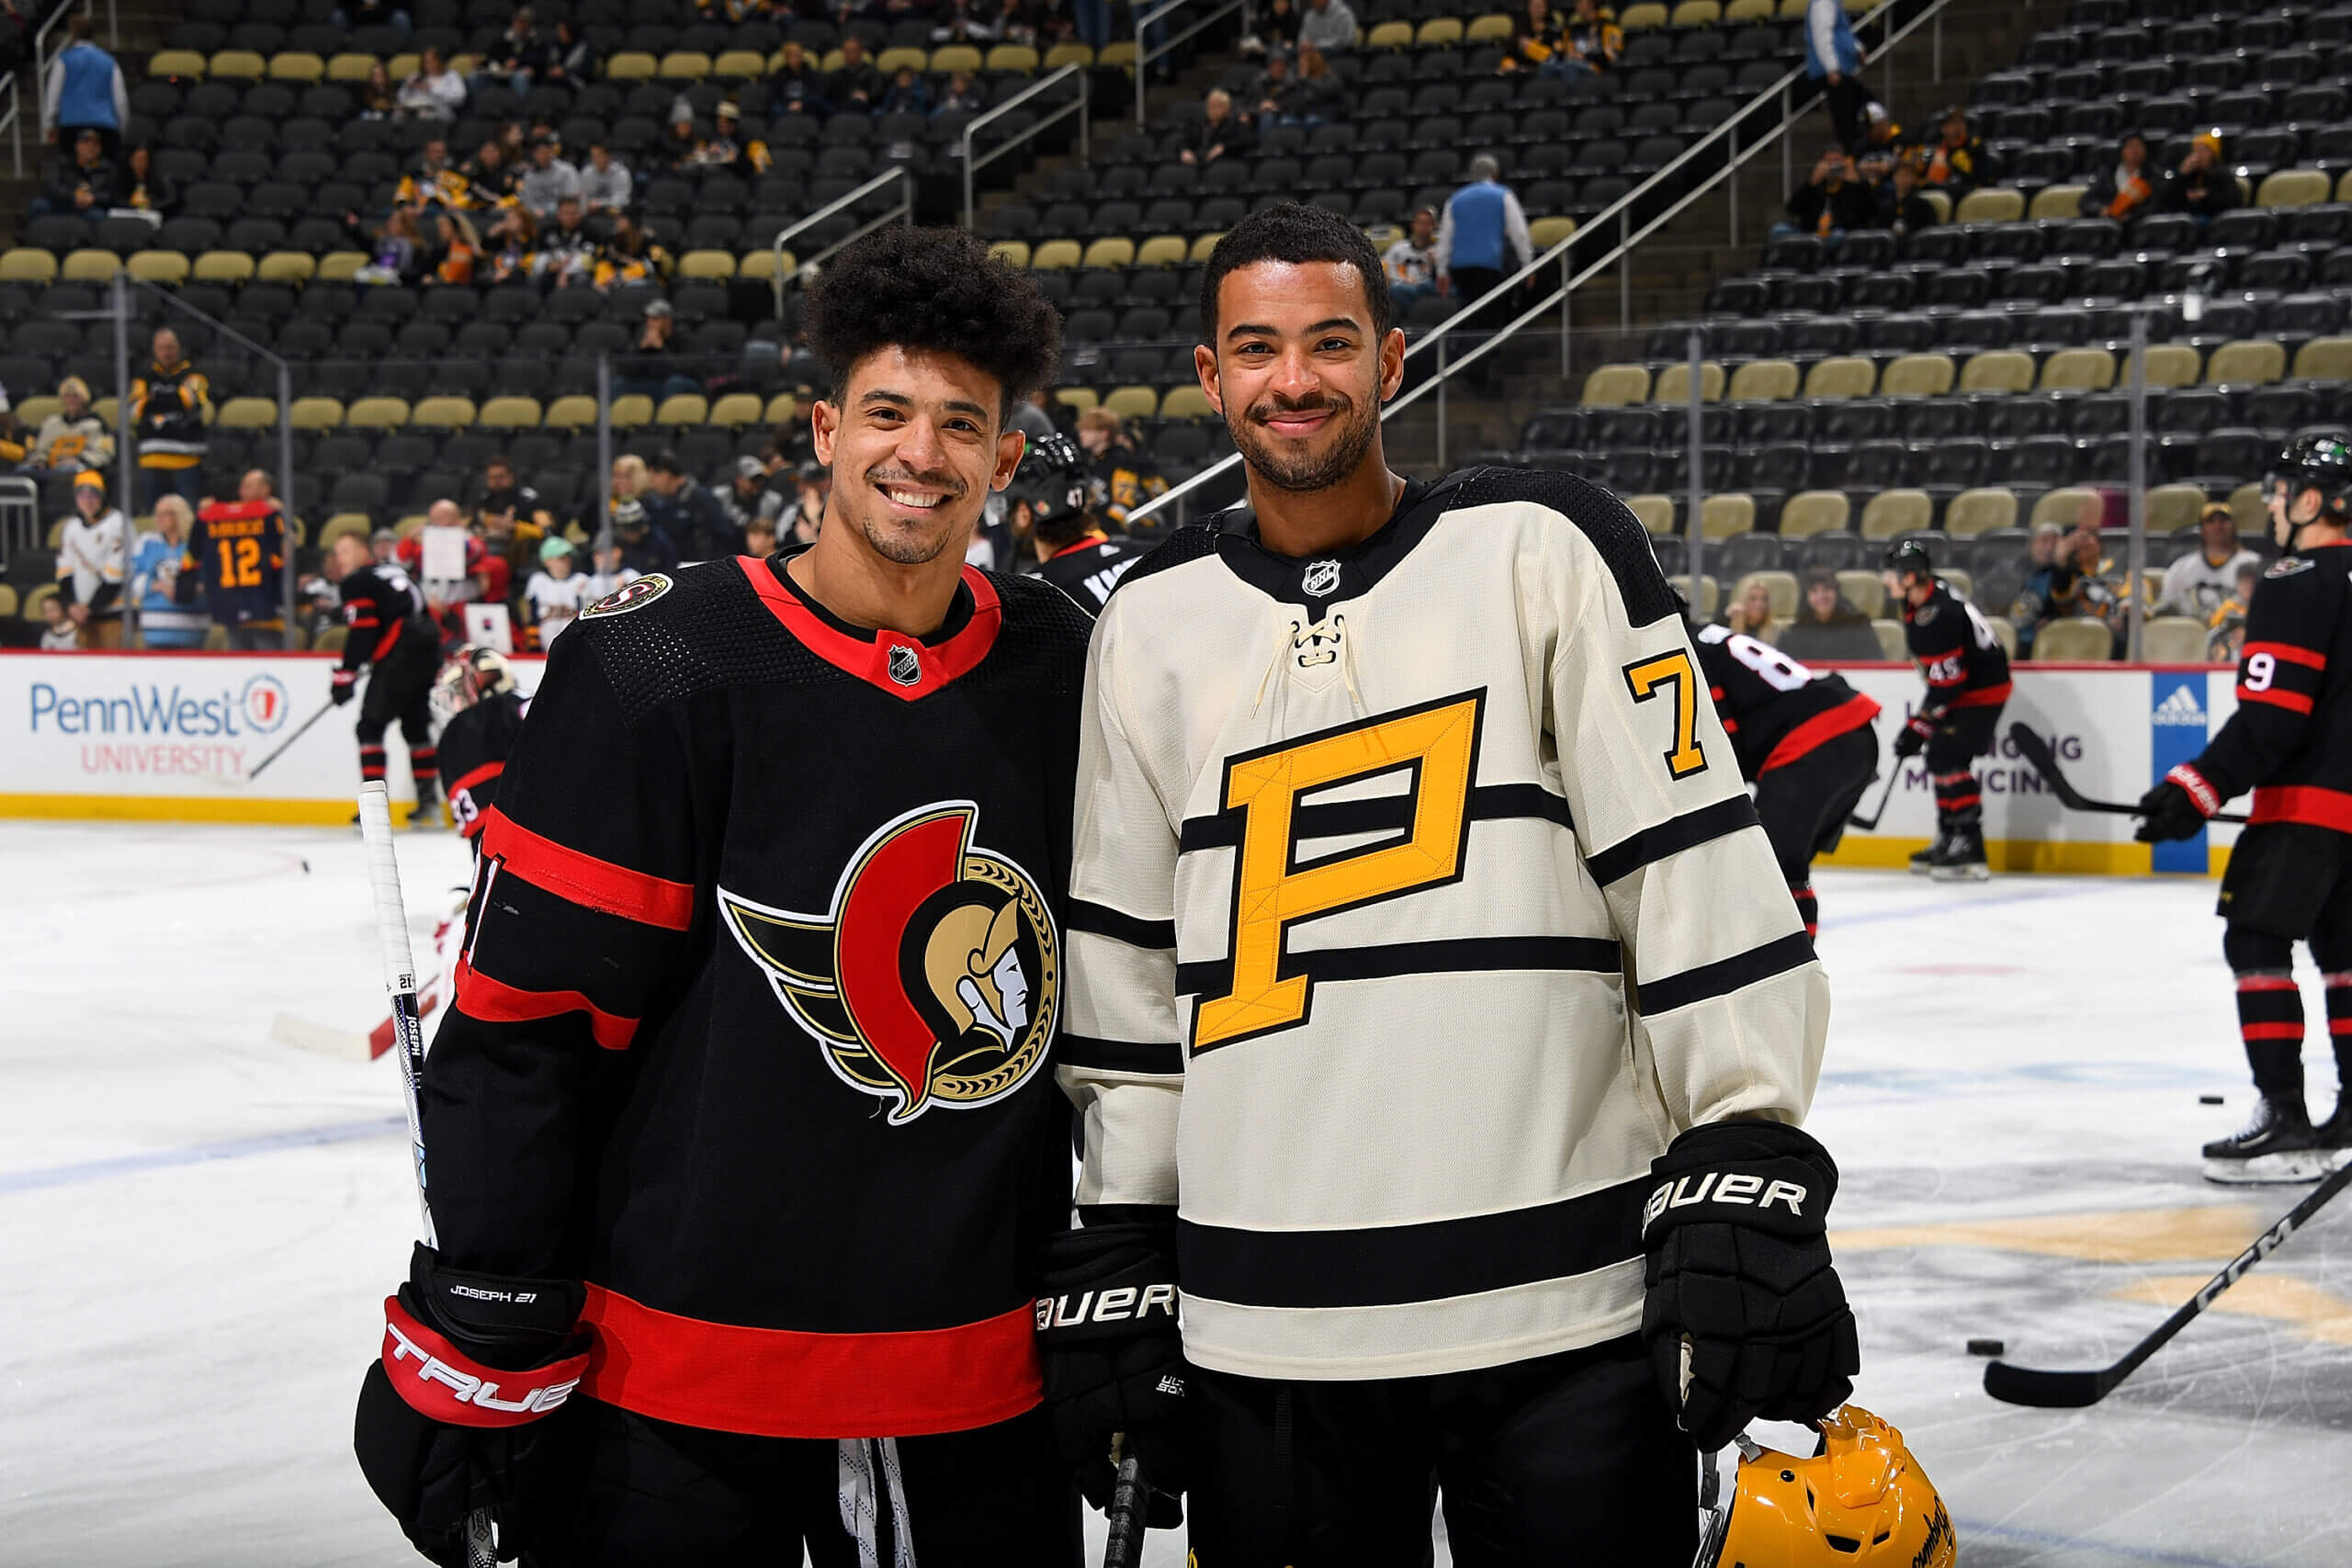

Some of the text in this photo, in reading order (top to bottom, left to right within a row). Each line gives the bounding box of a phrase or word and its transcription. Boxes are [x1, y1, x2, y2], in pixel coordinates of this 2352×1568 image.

[218, 536, 262, 588] 12
[2245, 651, 2276, 692] 9
[30, 682, 240, 736] PennWest
[1622, 647, 1709, 781] 7
[80, 743, 245, 775] UNIVERSITY
[1189, 685, 1487, 1058] P
[399, 977, 413, 989] 21
[405, 1014, 422, 1056] JOSEPH
[450, 1284, 537, 1303] JOSEPH 21
[1036, 1284, 1175, 1331] AUER
[387, 1323, 581, 1413] TRUE
